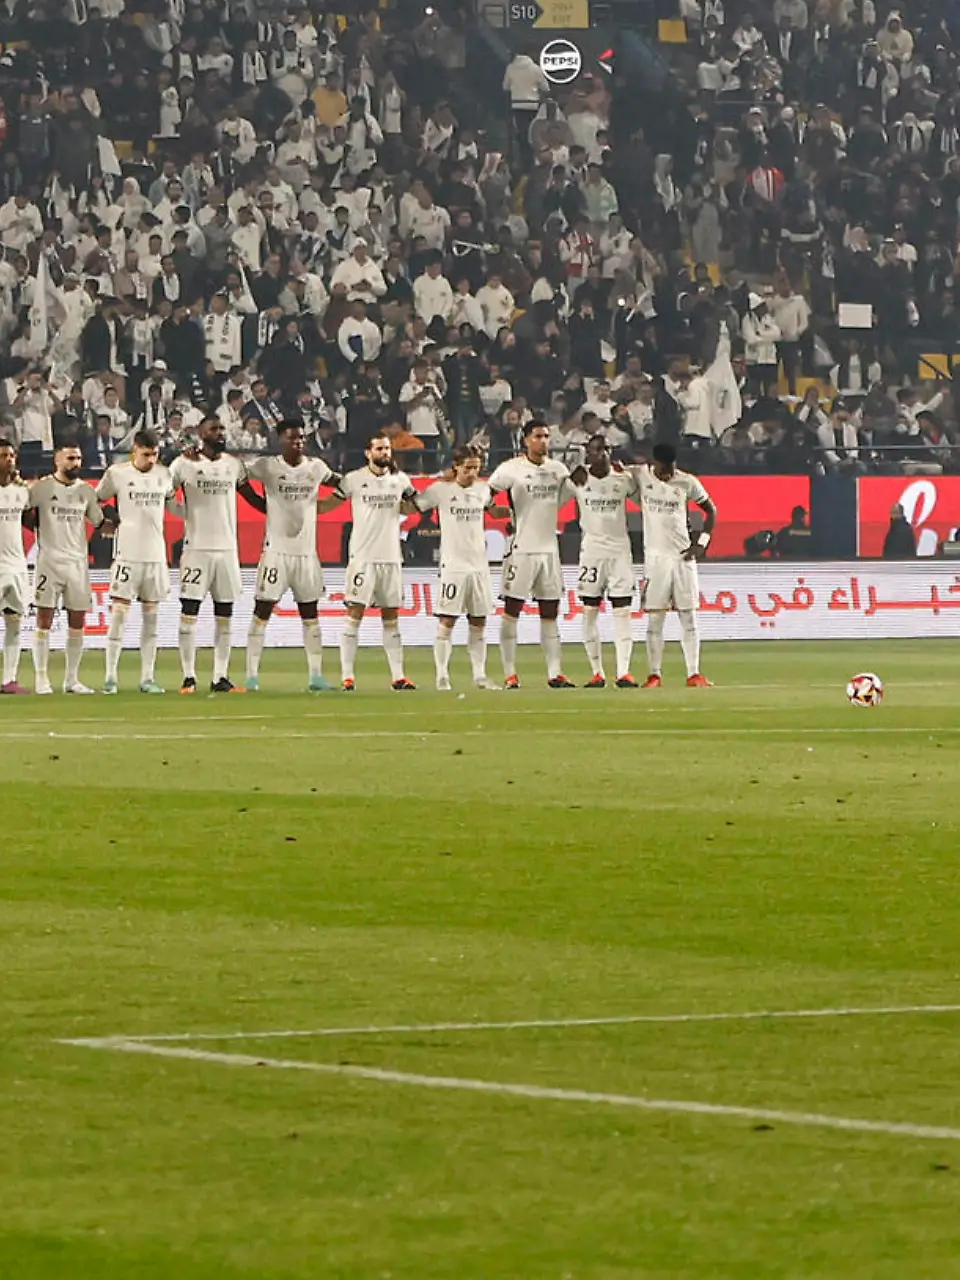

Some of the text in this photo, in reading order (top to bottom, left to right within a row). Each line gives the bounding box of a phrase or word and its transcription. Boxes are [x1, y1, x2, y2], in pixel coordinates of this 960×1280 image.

[511, 4, 536, 20] S10
[543, 56, 578, 66] PEPSI
[114, 565, 131, 582] 15
[181, 567, 203, 585] 22
[263, 567, 278, 584] 18
[353, 572, 365, 587] 6
[578, 566, 598, 583] 23
[36, 574, 48, 591] 2
[442, 583, 457, 600] 10
[747, 577, 815, 628] في
